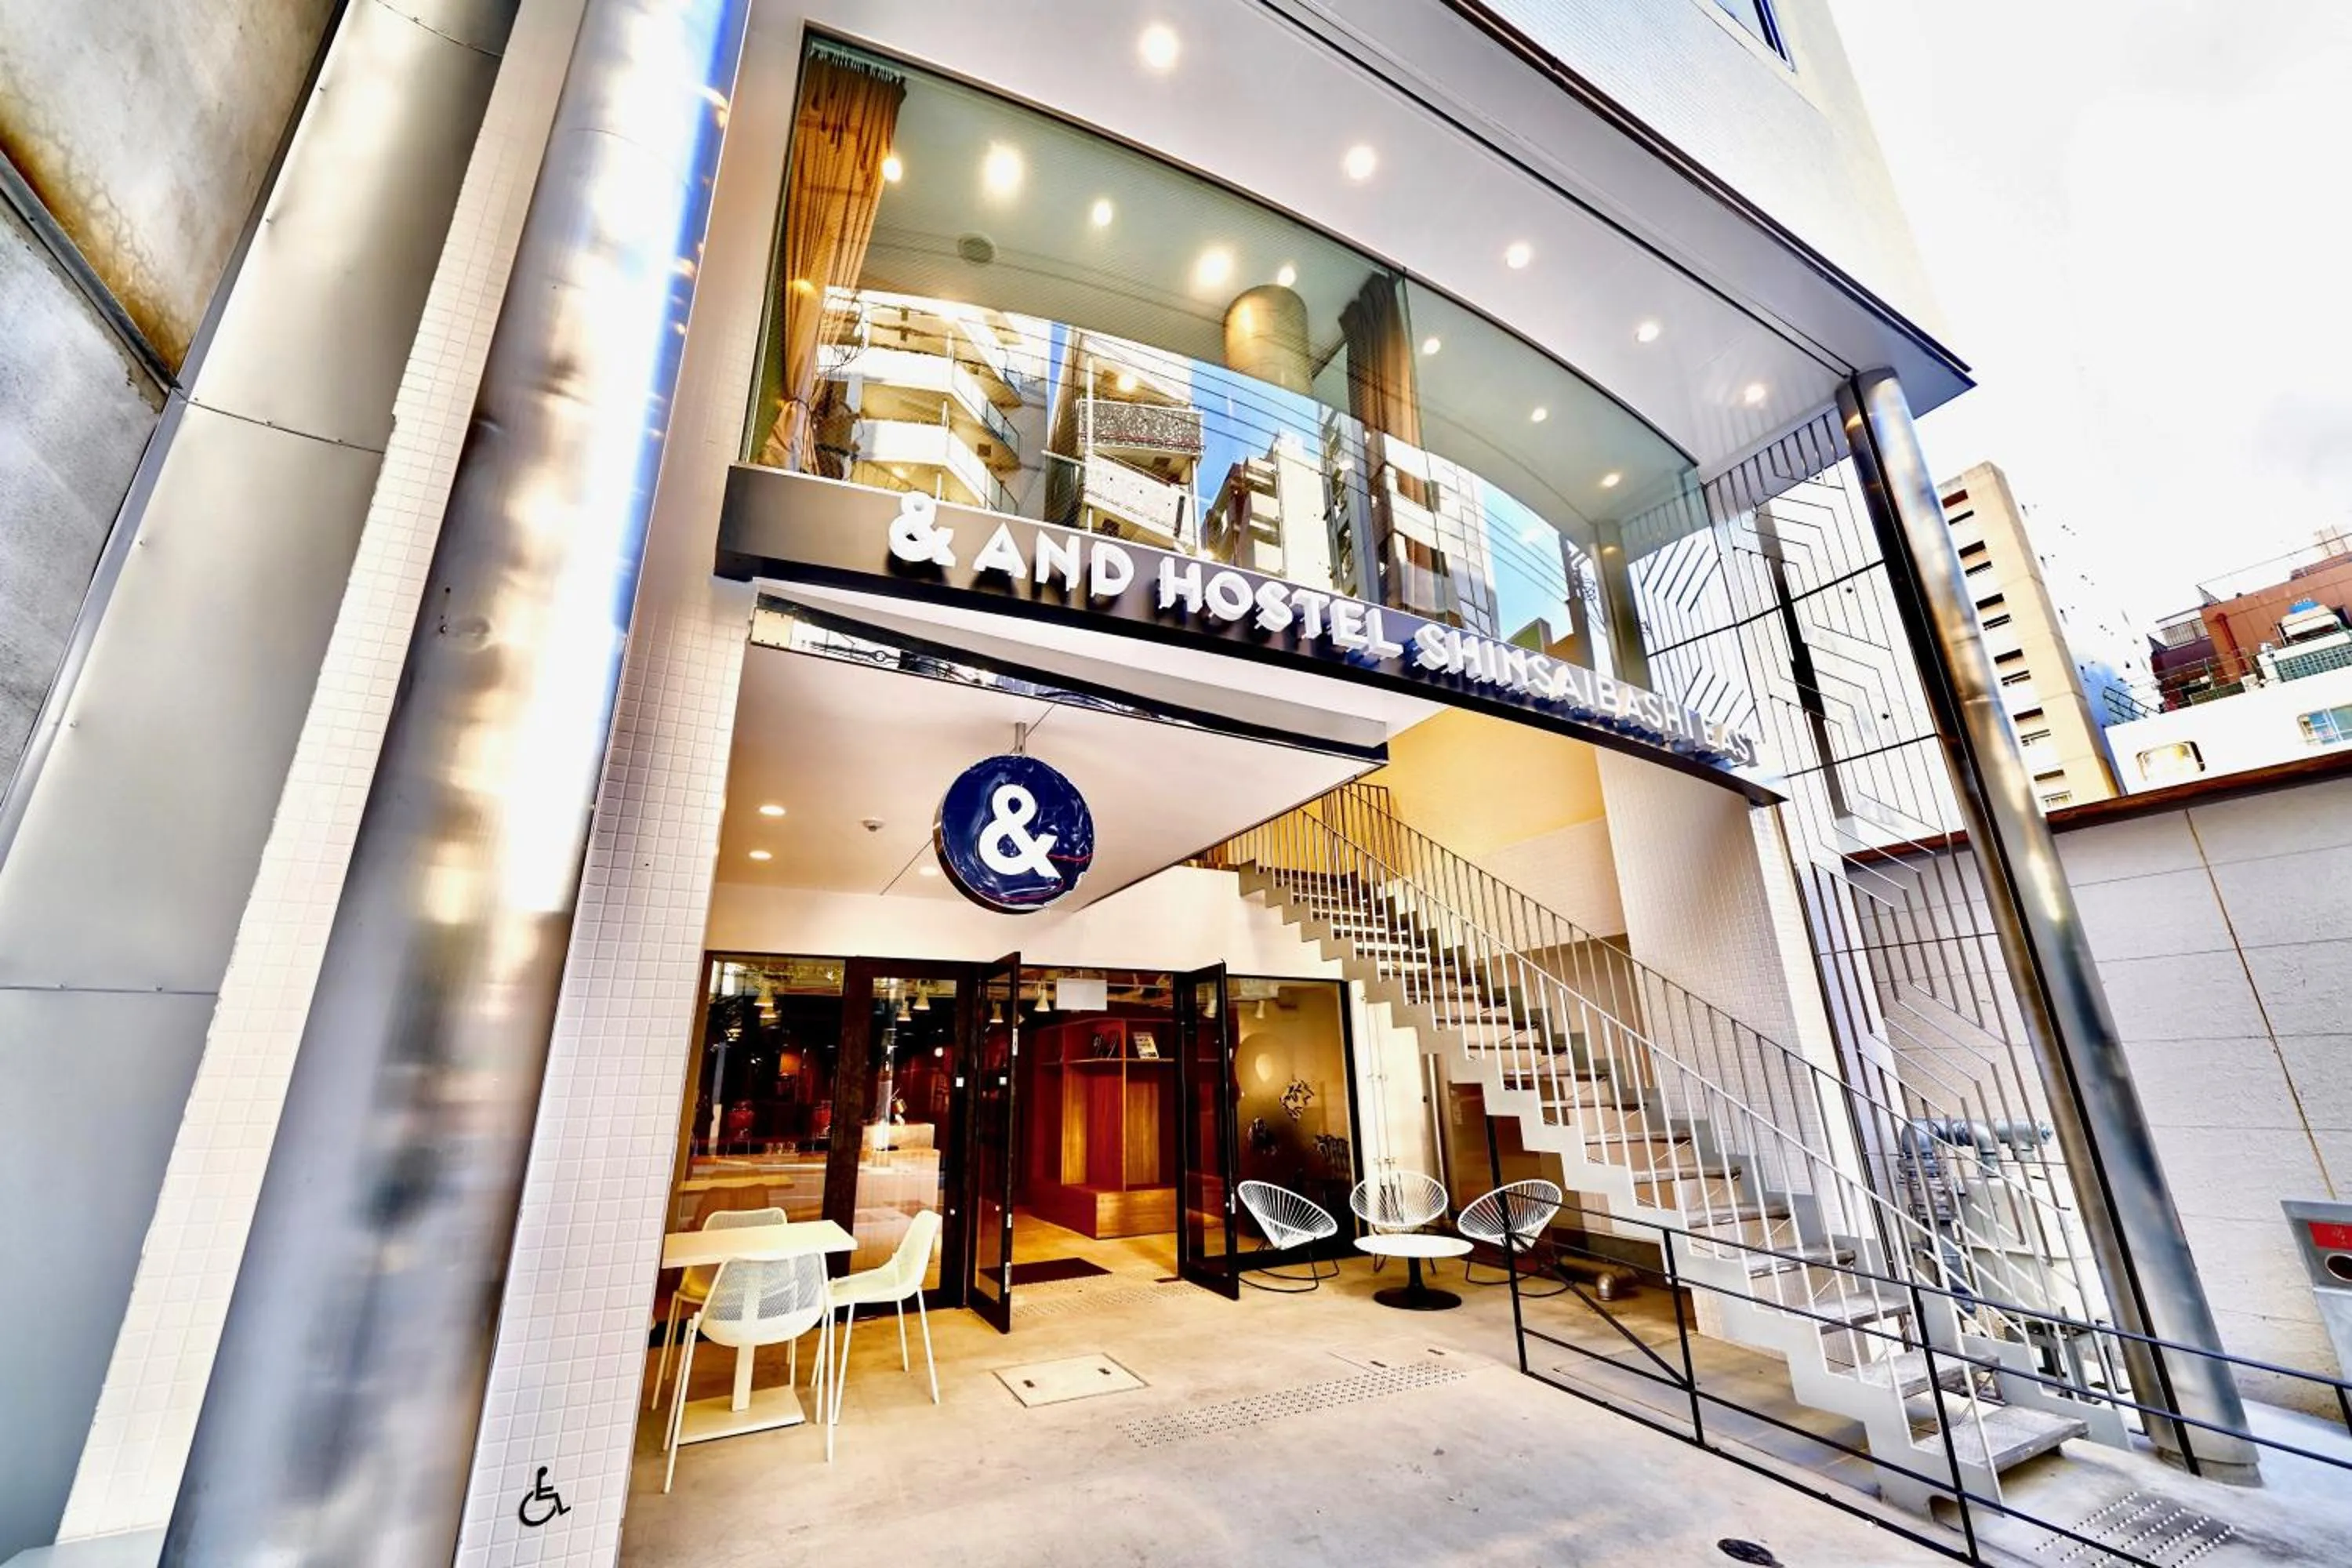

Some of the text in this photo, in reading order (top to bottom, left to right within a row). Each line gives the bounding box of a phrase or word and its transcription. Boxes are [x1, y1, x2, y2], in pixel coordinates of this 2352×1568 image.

[888, 491, 956, 567] &
[972, 522, 1135, 598] AND
[1158, 555, 1403, 660] HOSTEL
[1412, 623, 1694, 741] SHINSAIBASHI
[978, 783, 1062, 879] &
